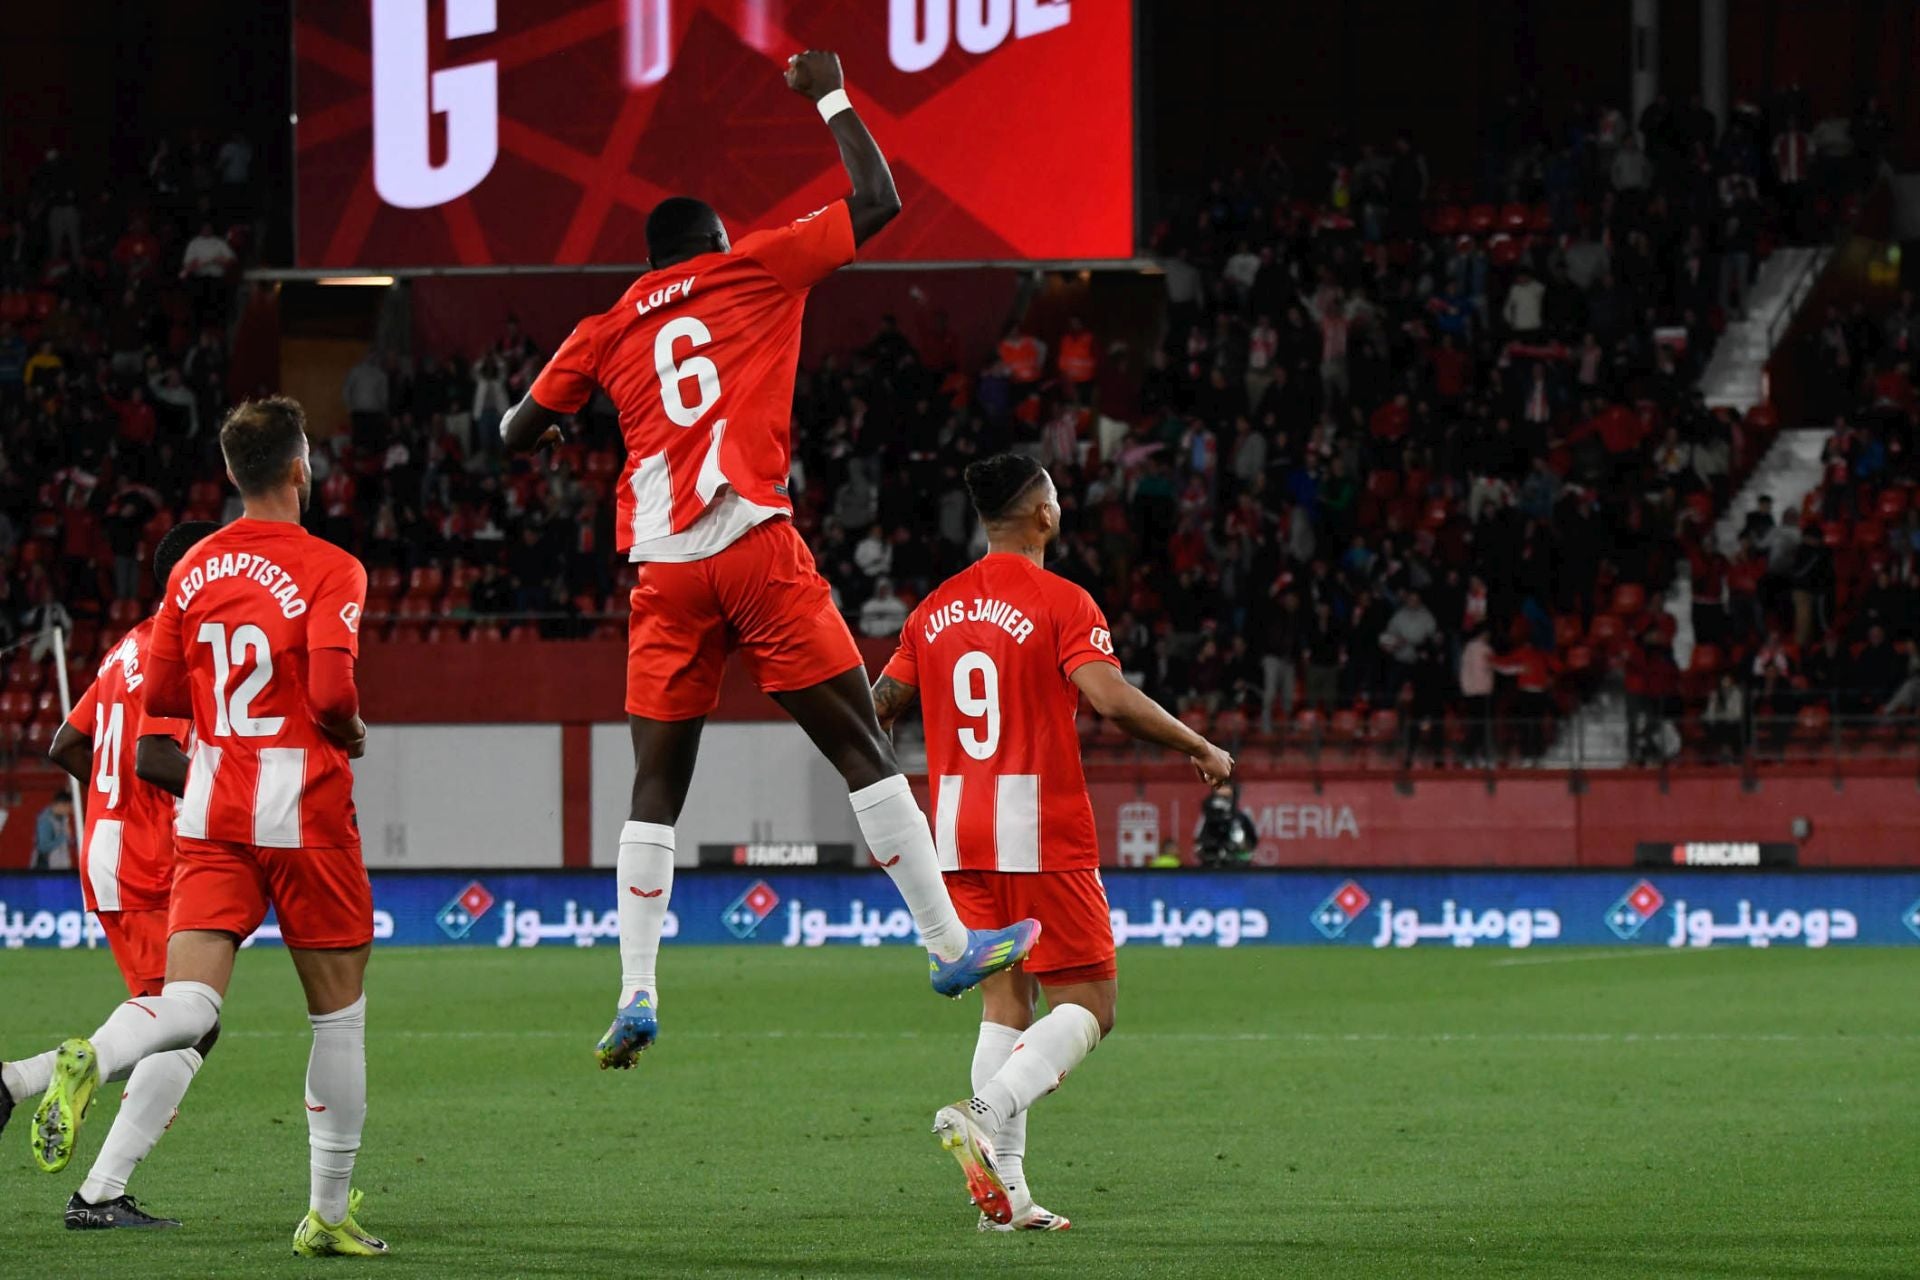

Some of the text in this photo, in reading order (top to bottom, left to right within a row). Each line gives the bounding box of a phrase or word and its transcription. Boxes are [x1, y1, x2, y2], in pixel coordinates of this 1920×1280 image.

[635, 275, 697, 316] LOPY
[653, 316, 722, 428] 6
[175, 552, 308, 620] LEO BAPTISTAO
[923, 598, 1036, 646] LUIS JAVIER
[196, 622, 287, 737] 12
[952, 650, 1001, 761] 9
[497, 900, 679, 949] دمينوز
[1373, 900, 1562, 949] دومينوز
[1668, 900, 1858, 949] دومينوز
